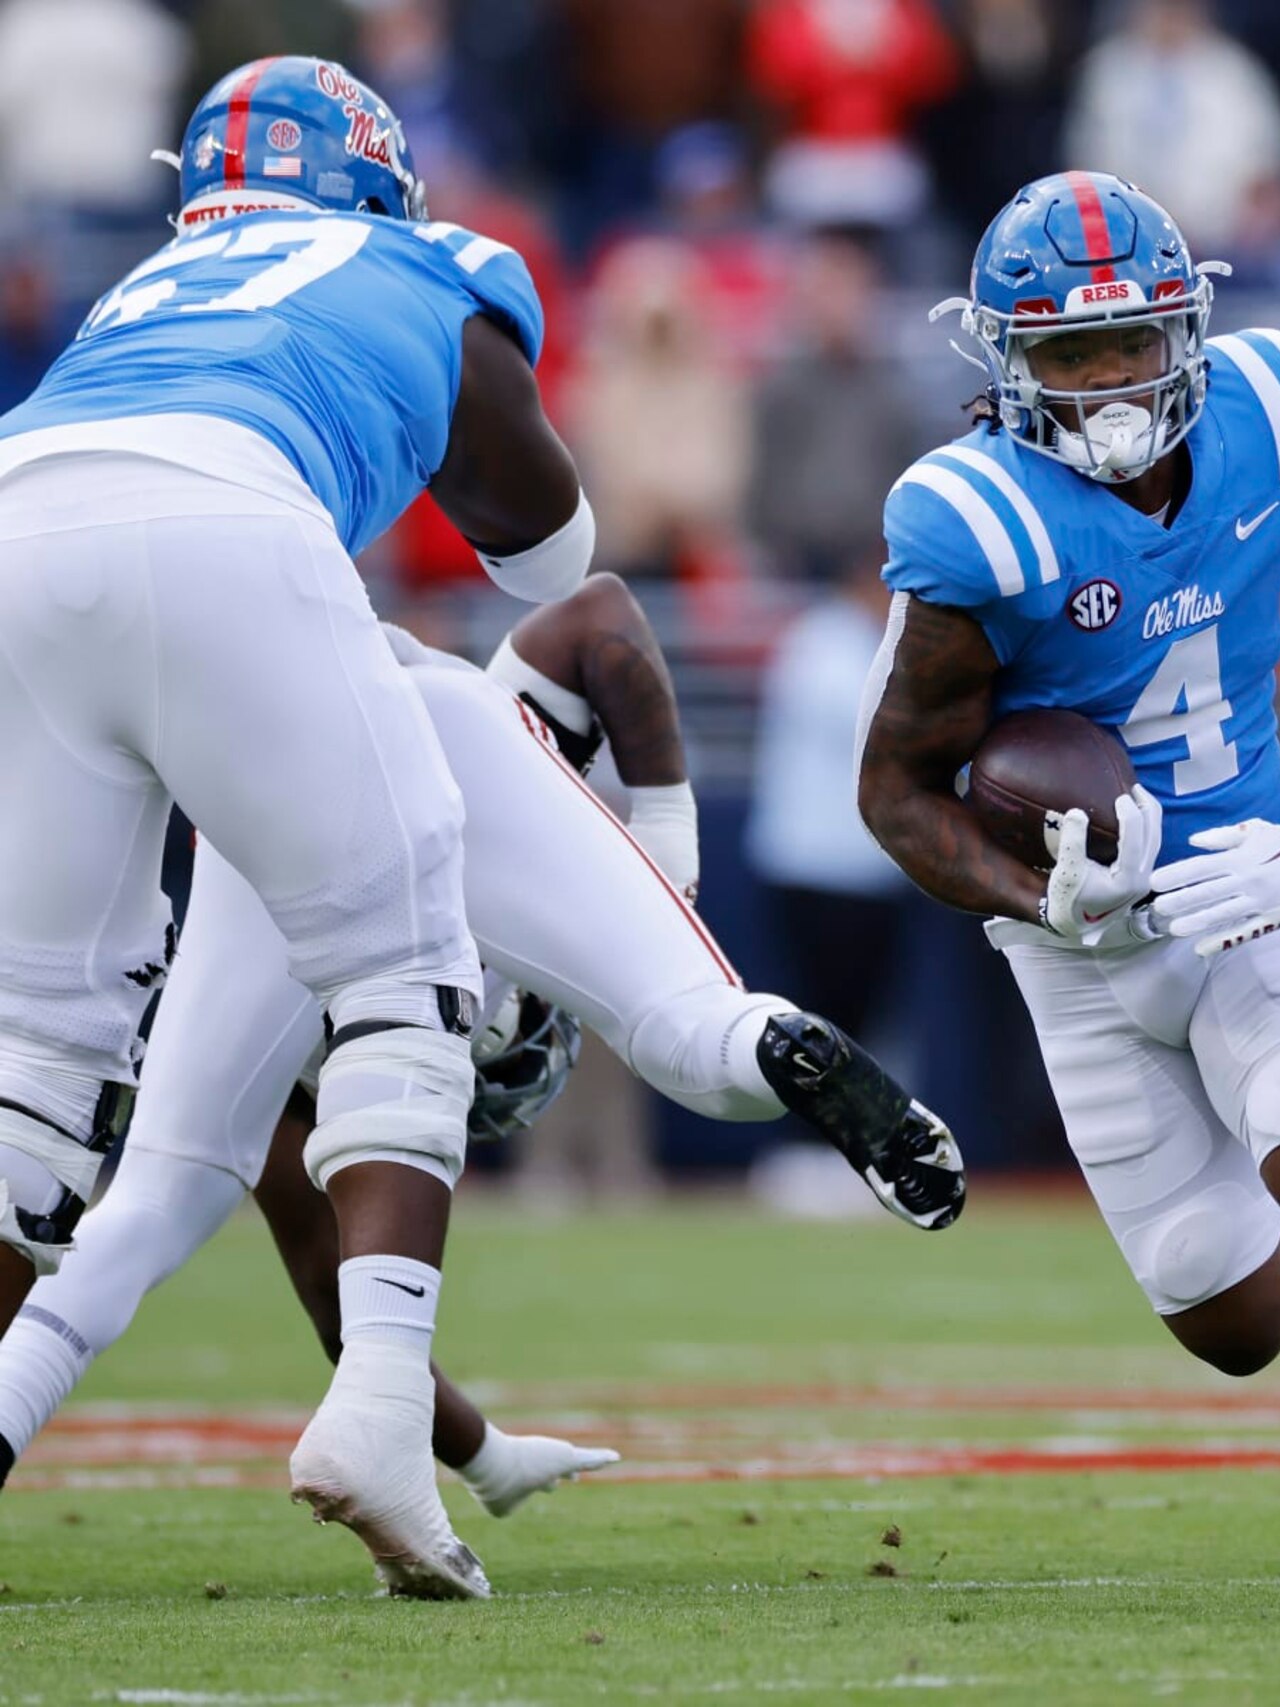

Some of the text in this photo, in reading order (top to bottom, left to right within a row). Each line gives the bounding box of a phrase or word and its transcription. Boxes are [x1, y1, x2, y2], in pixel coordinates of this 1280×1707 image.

[316, 62, 362, 104] Ole
[270, 121, 299, 150] SEC
[342, 104, 394, 168] Mis
[1082, 284, 1129, 303] REBS
[1071, 582, 1118, 629] SEC
[1142, 583, 1226, 640] Ole Miss
[1117, 623, 1239, 797] 4
